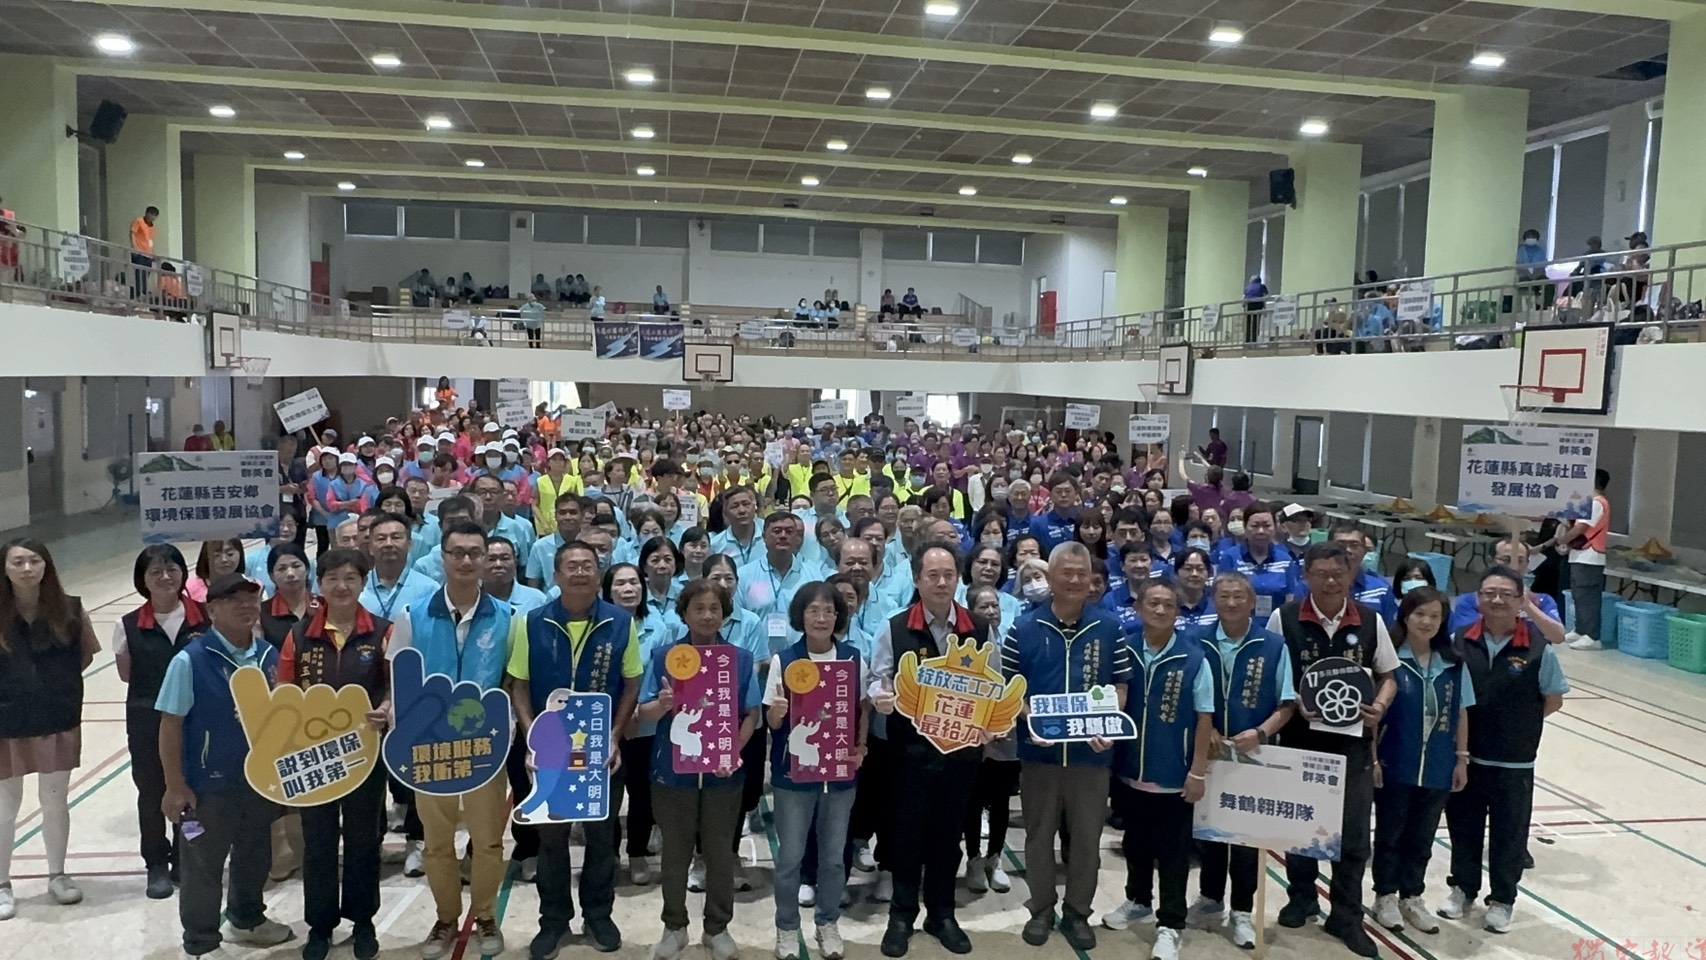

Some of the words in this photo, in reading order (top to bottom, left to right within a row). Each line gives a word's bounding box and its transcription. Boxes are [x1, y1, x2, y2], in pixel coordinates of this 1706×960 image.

[1466, 459, 1588, 480] 花蓮縣真誠社區
[160, 484, 259, 502] 花蓮縣吉安鄉
[1490, 481, 1560, 500] 發展協會
[144, 503, 275, 522] 環境保護發展協會
[917, 666, 1004, 700] 綻放志工力
[1305, 671, 1318, 688] 17
[716, 653, 733, 770] 今日我是大明星
[934, 693, 976, 720] 花蓮
[1033, 695, 1089, 715] 我環保
[835, 669, 849, 778] 今日我是大明星
[920, 714, 982, 744] 最給力
[1066, 716, 1124, 736] 我驕傲
[275, 732, 362, 778] 說到環保
[411, 737, 492, 764] 環境服務
[587, 701, 604, 816] 今日我是大明星
[282, 758, 366, 799] 叫我第一
[412, 759, 492, 784] 我衝第一
[1302, 770, 1340, 787] 群英會
